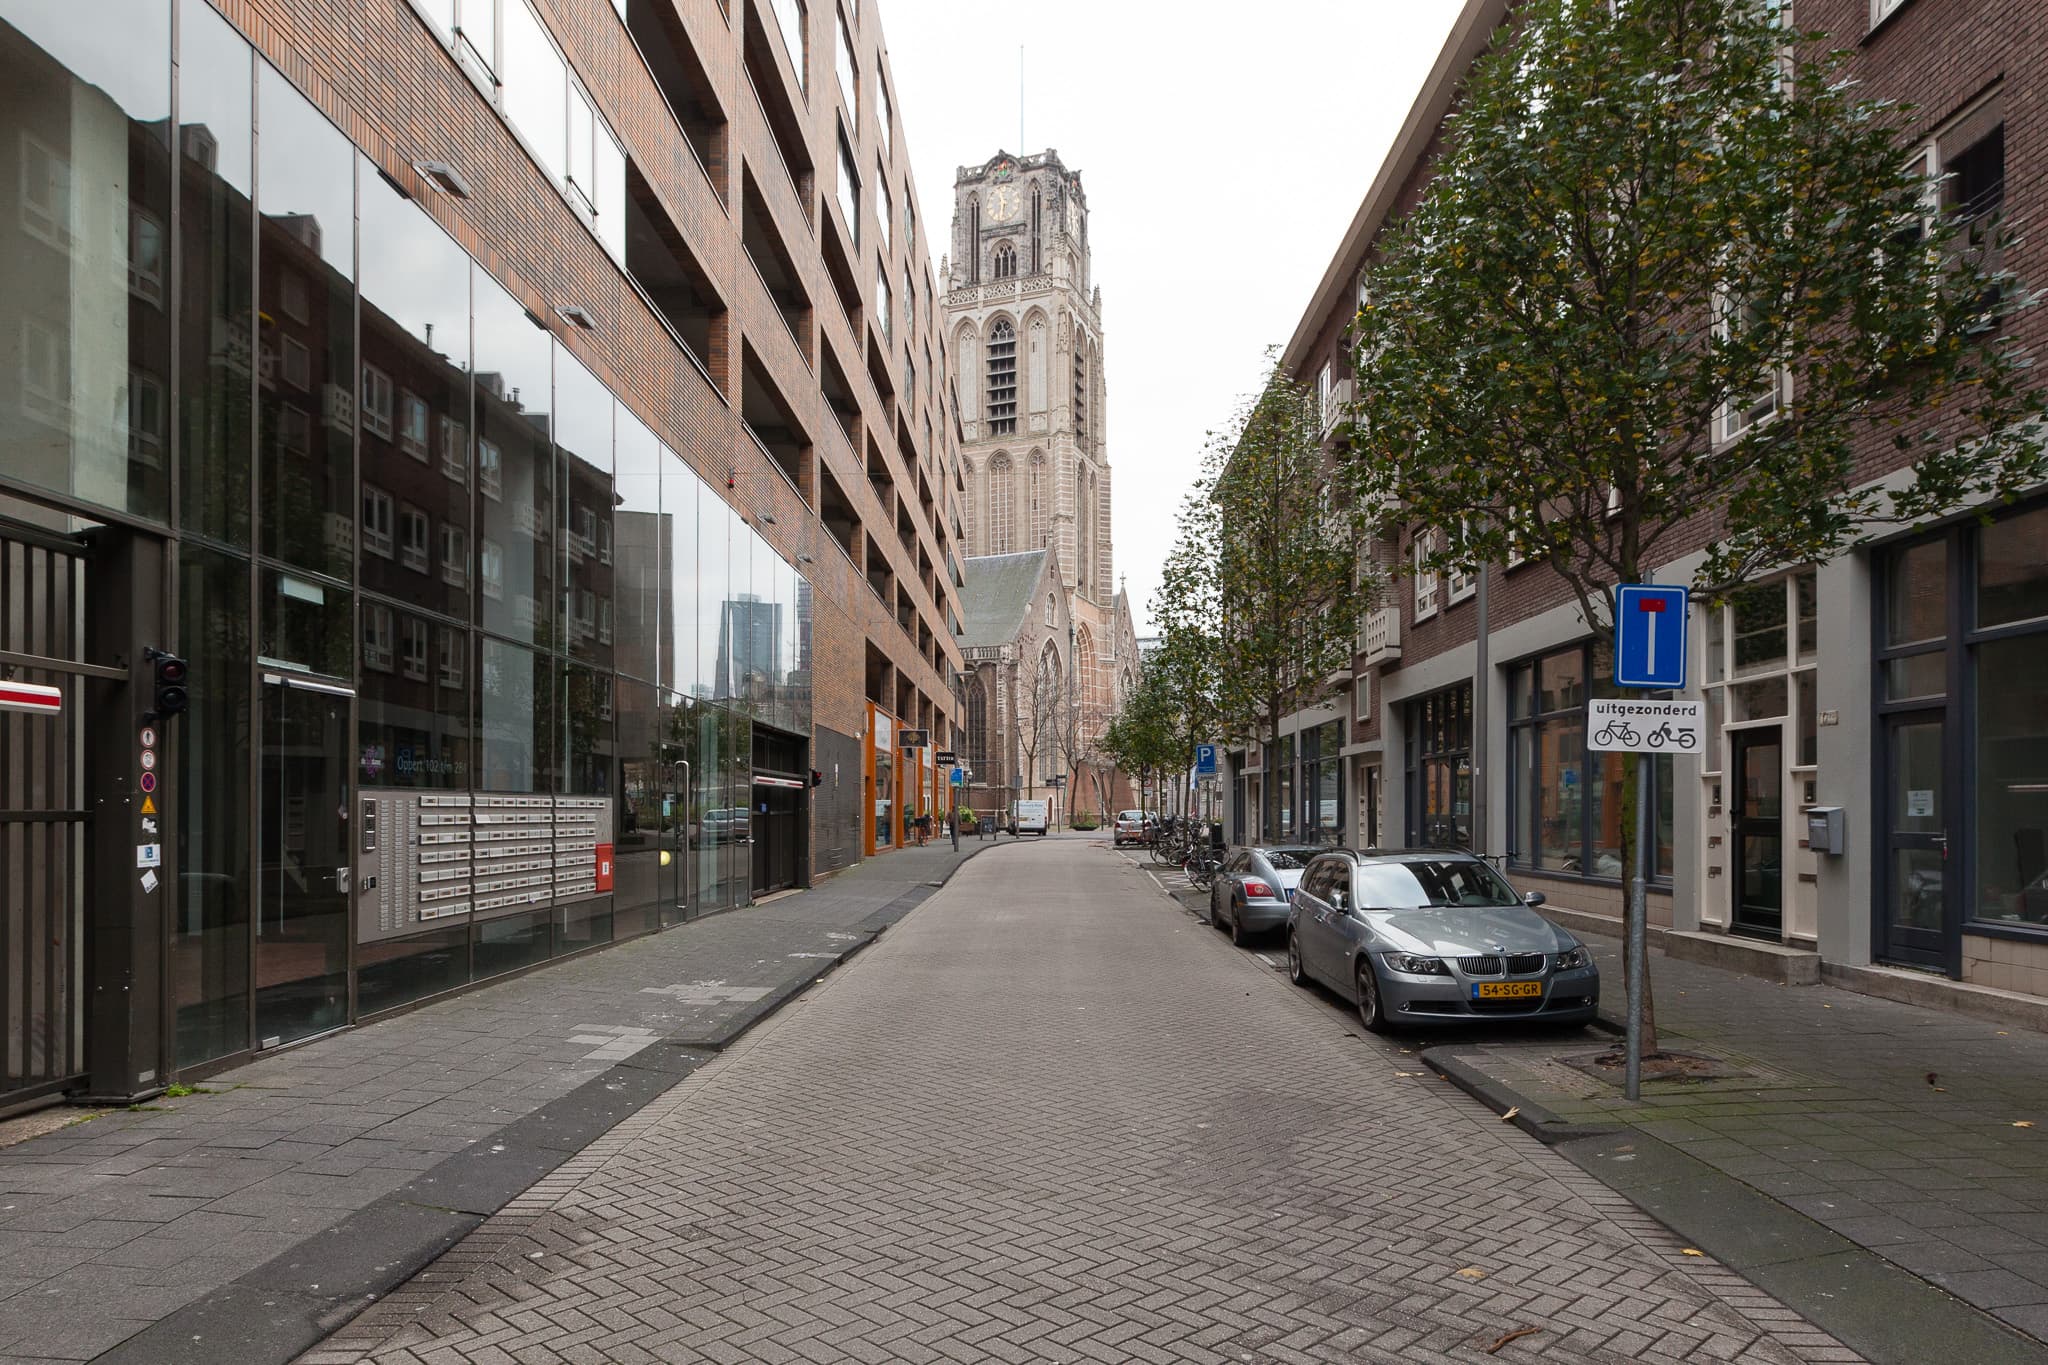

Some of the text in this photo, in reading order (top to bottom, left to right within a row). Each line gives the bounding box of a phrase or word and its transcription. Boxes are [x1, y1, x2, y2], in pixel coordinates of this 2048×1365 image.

[1597, 703, 1697, 717] uitgezonderd
[1200, 747, 1211, 762] P
[1483, 984, 1538, 996] 54-SG-GR
